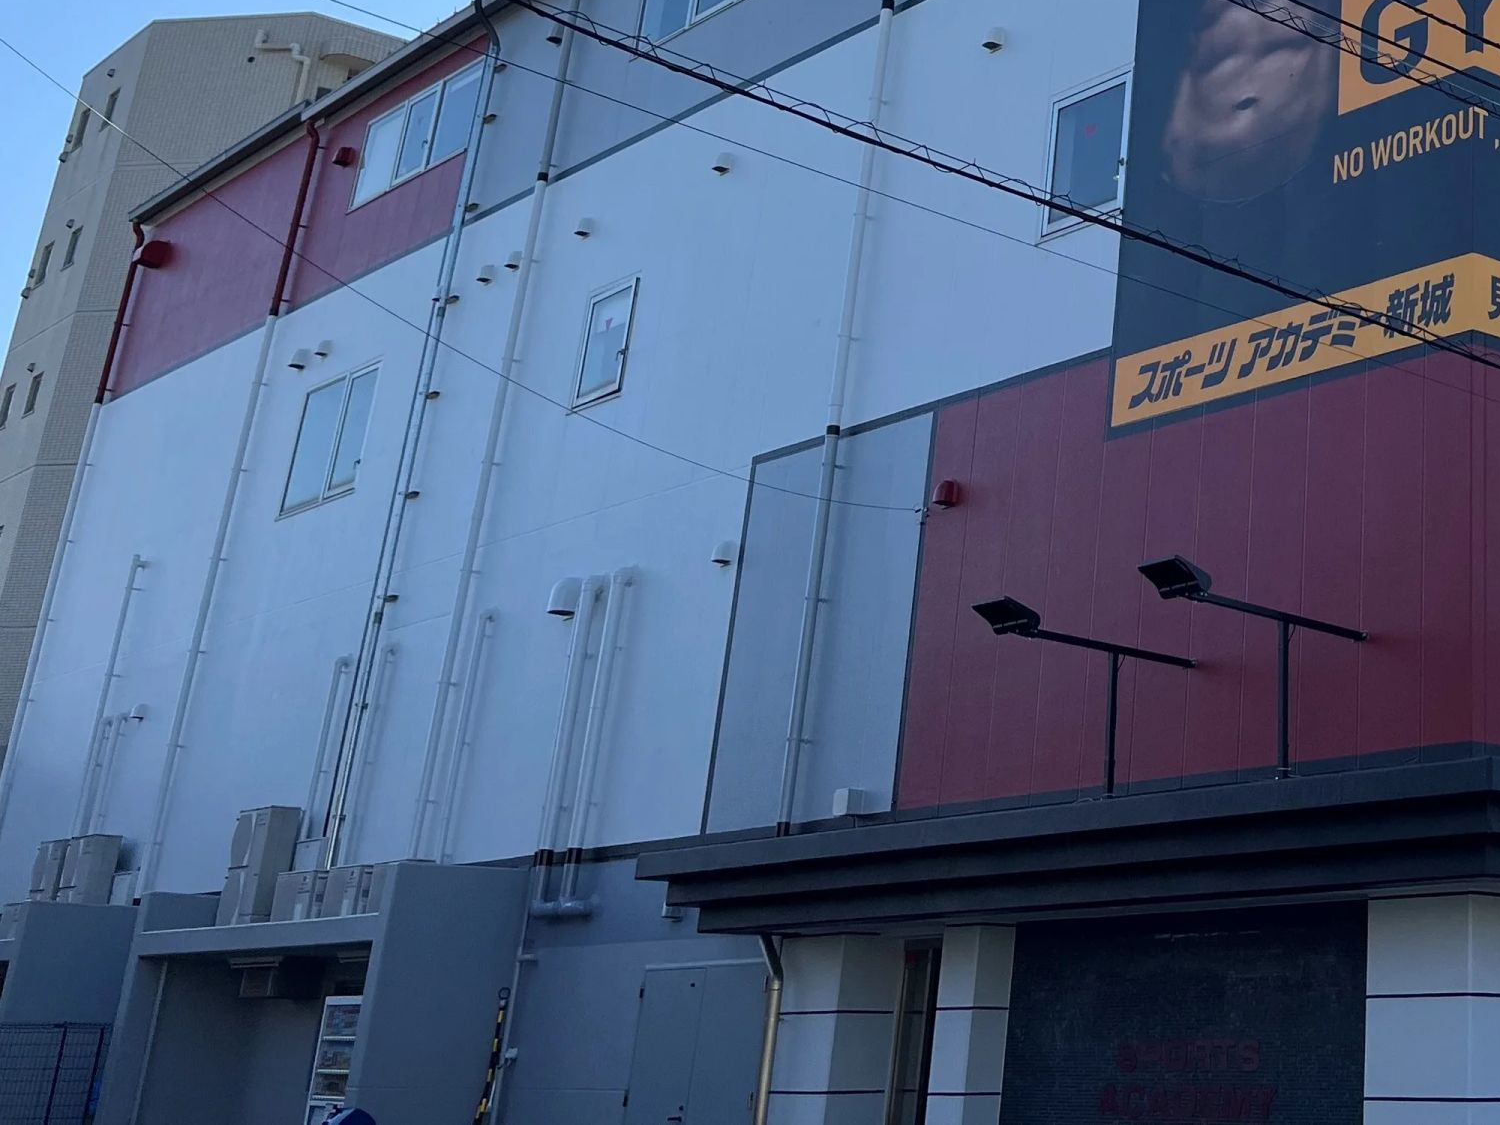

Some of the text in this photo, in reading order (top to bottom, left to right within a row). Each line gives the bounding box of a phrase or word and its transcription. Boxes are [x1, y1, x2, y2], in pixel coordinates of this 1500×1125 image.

[1333, 146, 1364, 184] NO
[1128, 338, 1237, 409] スポーツ
